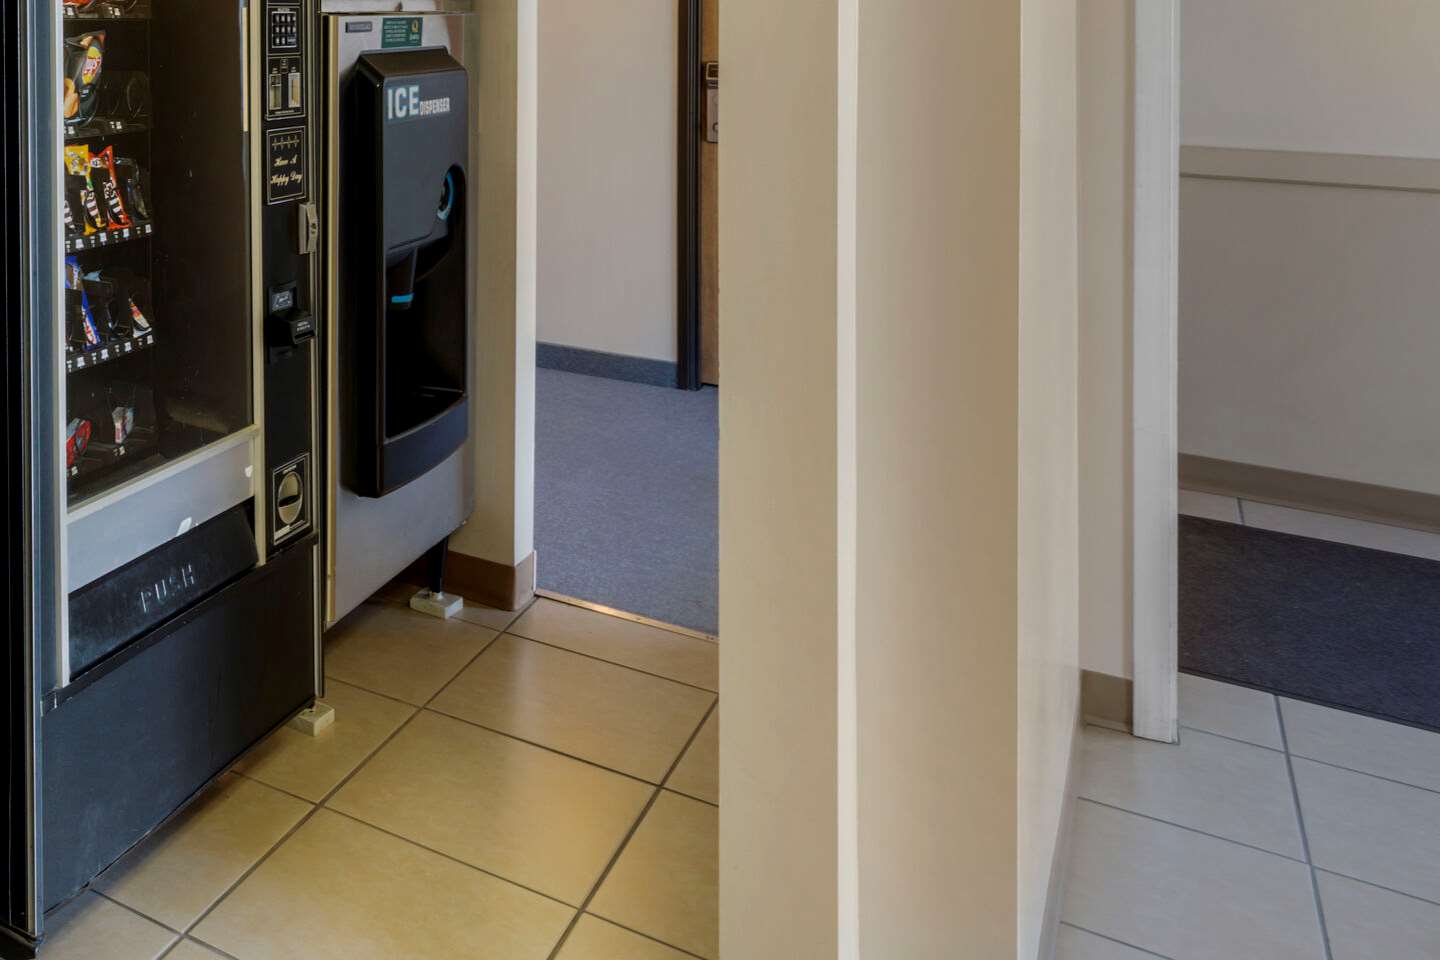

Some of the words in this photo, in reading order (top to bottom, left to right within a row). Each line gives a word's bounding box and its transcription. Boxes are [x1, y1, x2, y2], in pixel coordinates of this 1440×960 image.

[387, 85, 420, 120] ICE
[419, 97, 451, 116] DISPENSER
[289, 171, 303, 183] Day
[140, 564, 195, 613] PUSH
